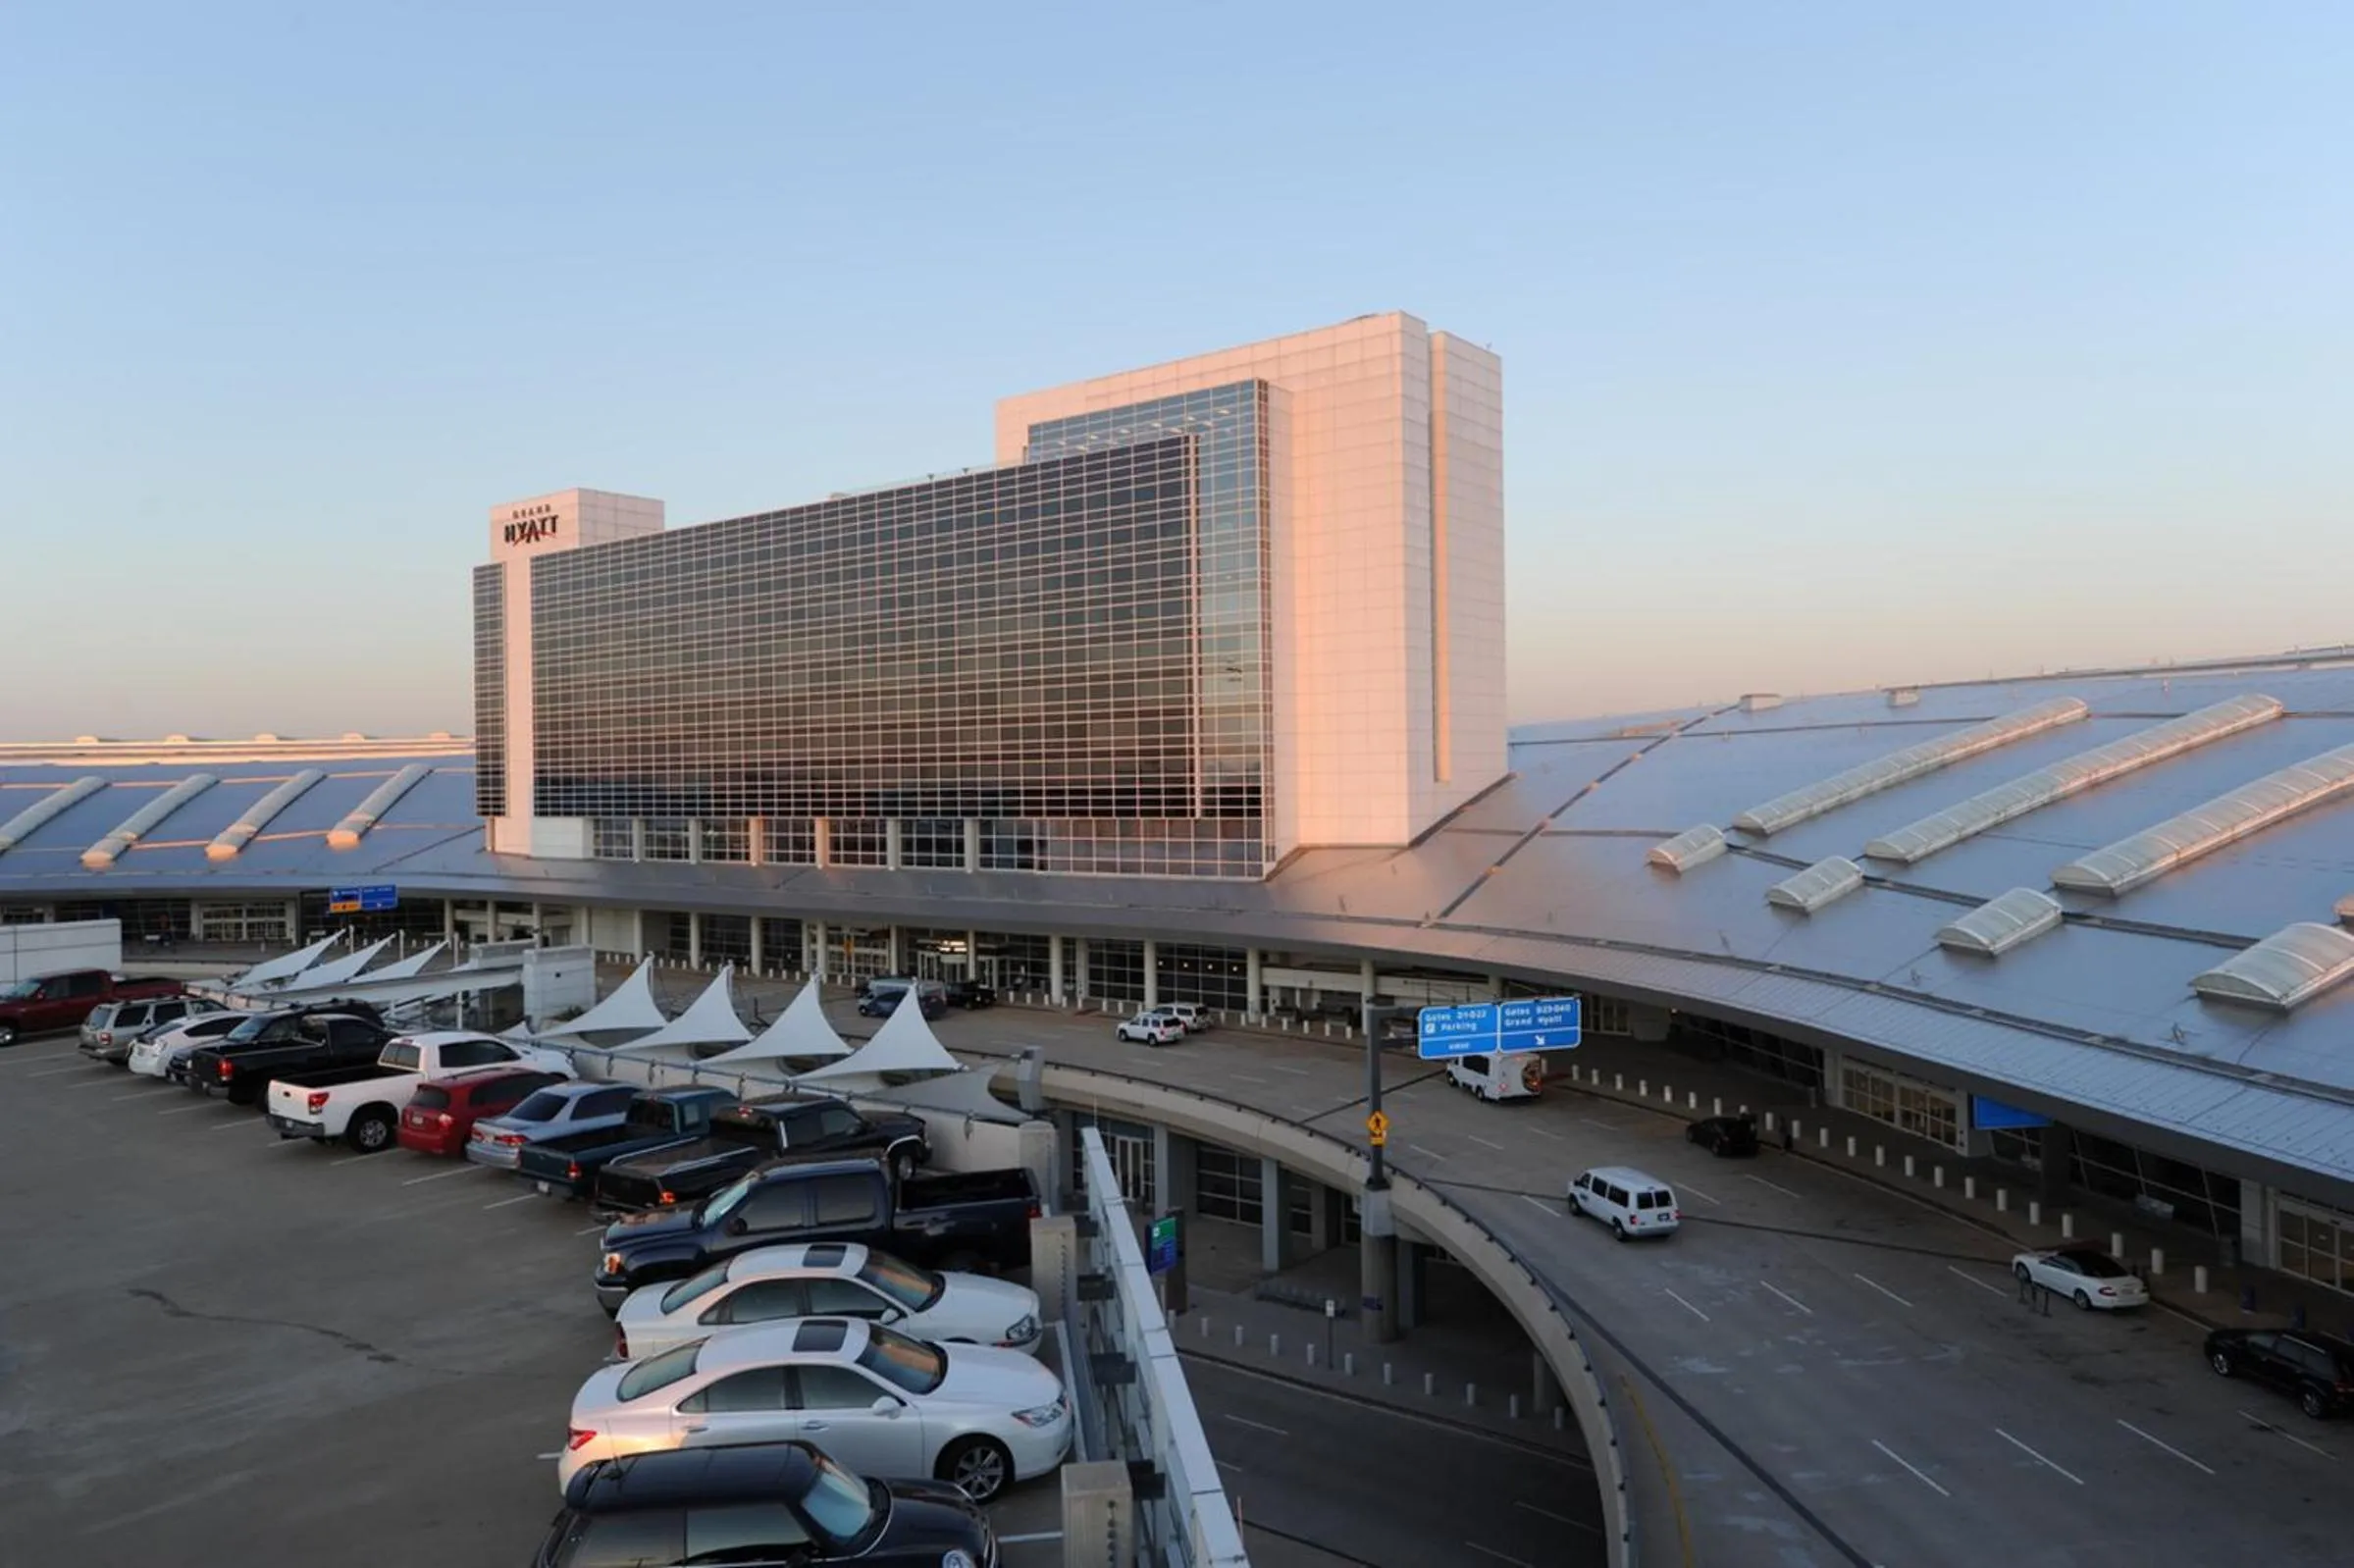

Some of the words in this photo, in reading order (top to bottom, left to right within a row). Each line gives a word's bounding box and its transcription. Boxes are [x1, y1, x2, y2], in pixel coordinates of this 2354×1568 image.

[512, 503, 551, 519] GRAND
[504, 514, 559, 545] HYATT
[1425, 1012, 1450, 1022] Gates
[1504, 1007, 1531, 1017] Gates
[1440, 1020, 1477, 1031] Parking
[1504, 1016, 1533, 1026] Grand
[1538, 1015, 1562, 1026] Hyatt
